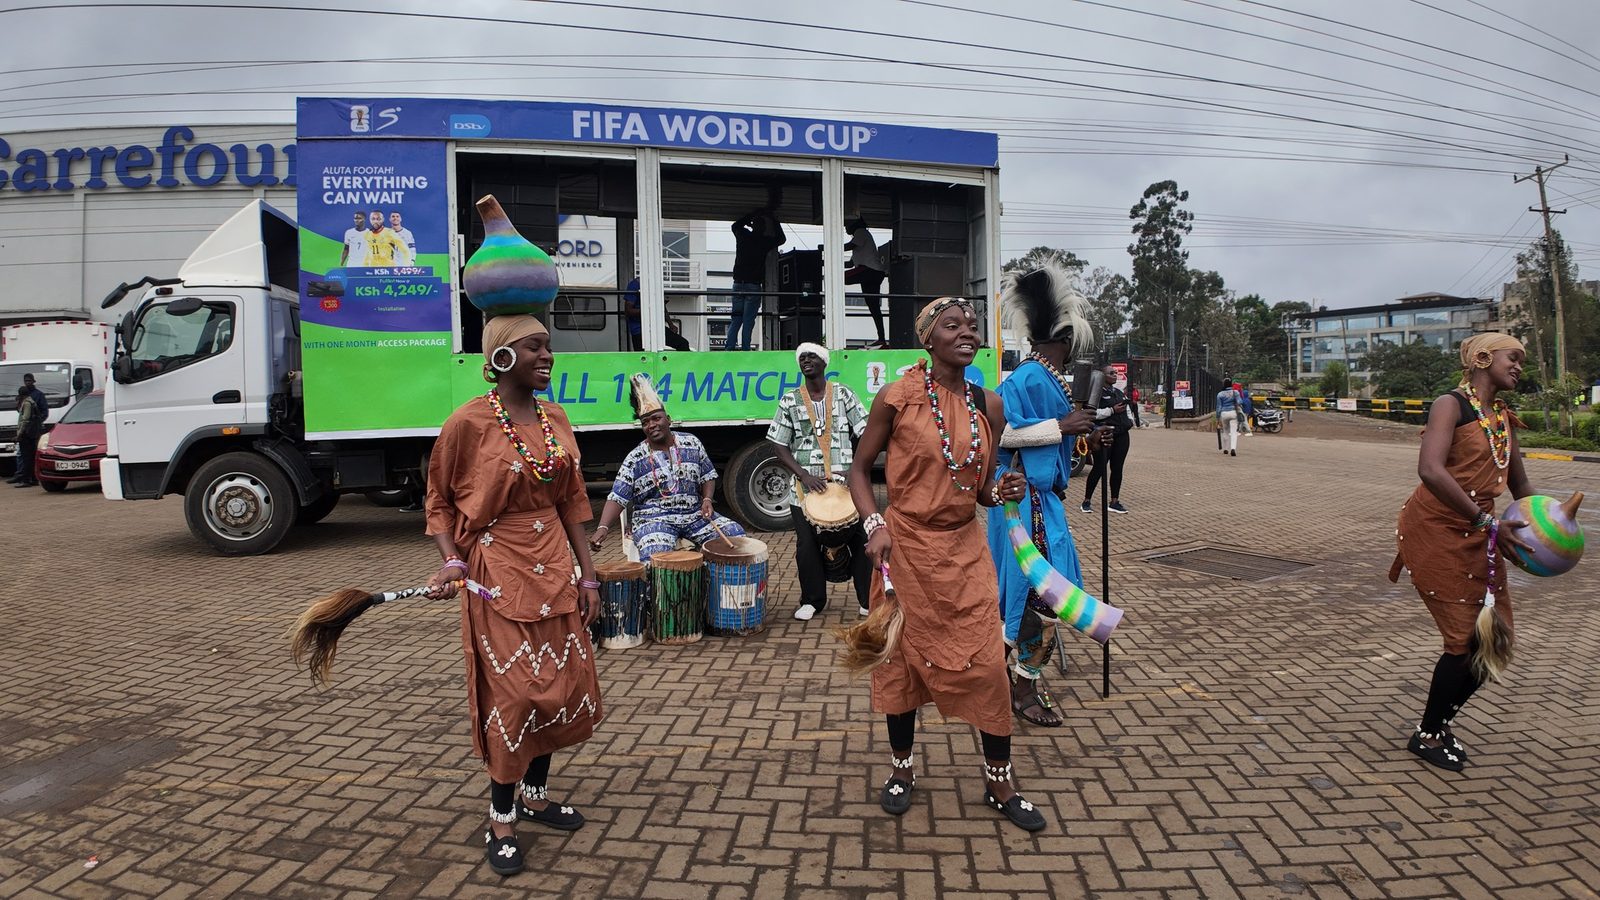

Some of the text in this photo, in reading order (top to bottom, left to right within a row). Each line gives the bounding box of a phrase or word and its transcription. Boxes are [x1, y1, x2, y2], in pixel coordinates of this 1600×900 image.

[572, 110, 650, 141] FIFA
[658, 114, 793, 147] WORLD
[0, 126, 297, 192] arrefou
[322, 166, 394, 174] ALUTA FOOTAH!
[322, 176, 429, 189] EVERYTHING
[322, 191, 405, 205] CAN WAIT
[374, 268, 390, 276] KSh
[355, 283, 439, 297] KSh 4,249/-
[304, 341, 326, 349] WITH
[345, 339, 377, 348] MONTH
[378, 339, 408, 347] ACCESS
[409, 338, 447, 346] PACKAGE
[613, 372, 673, 403] 14
